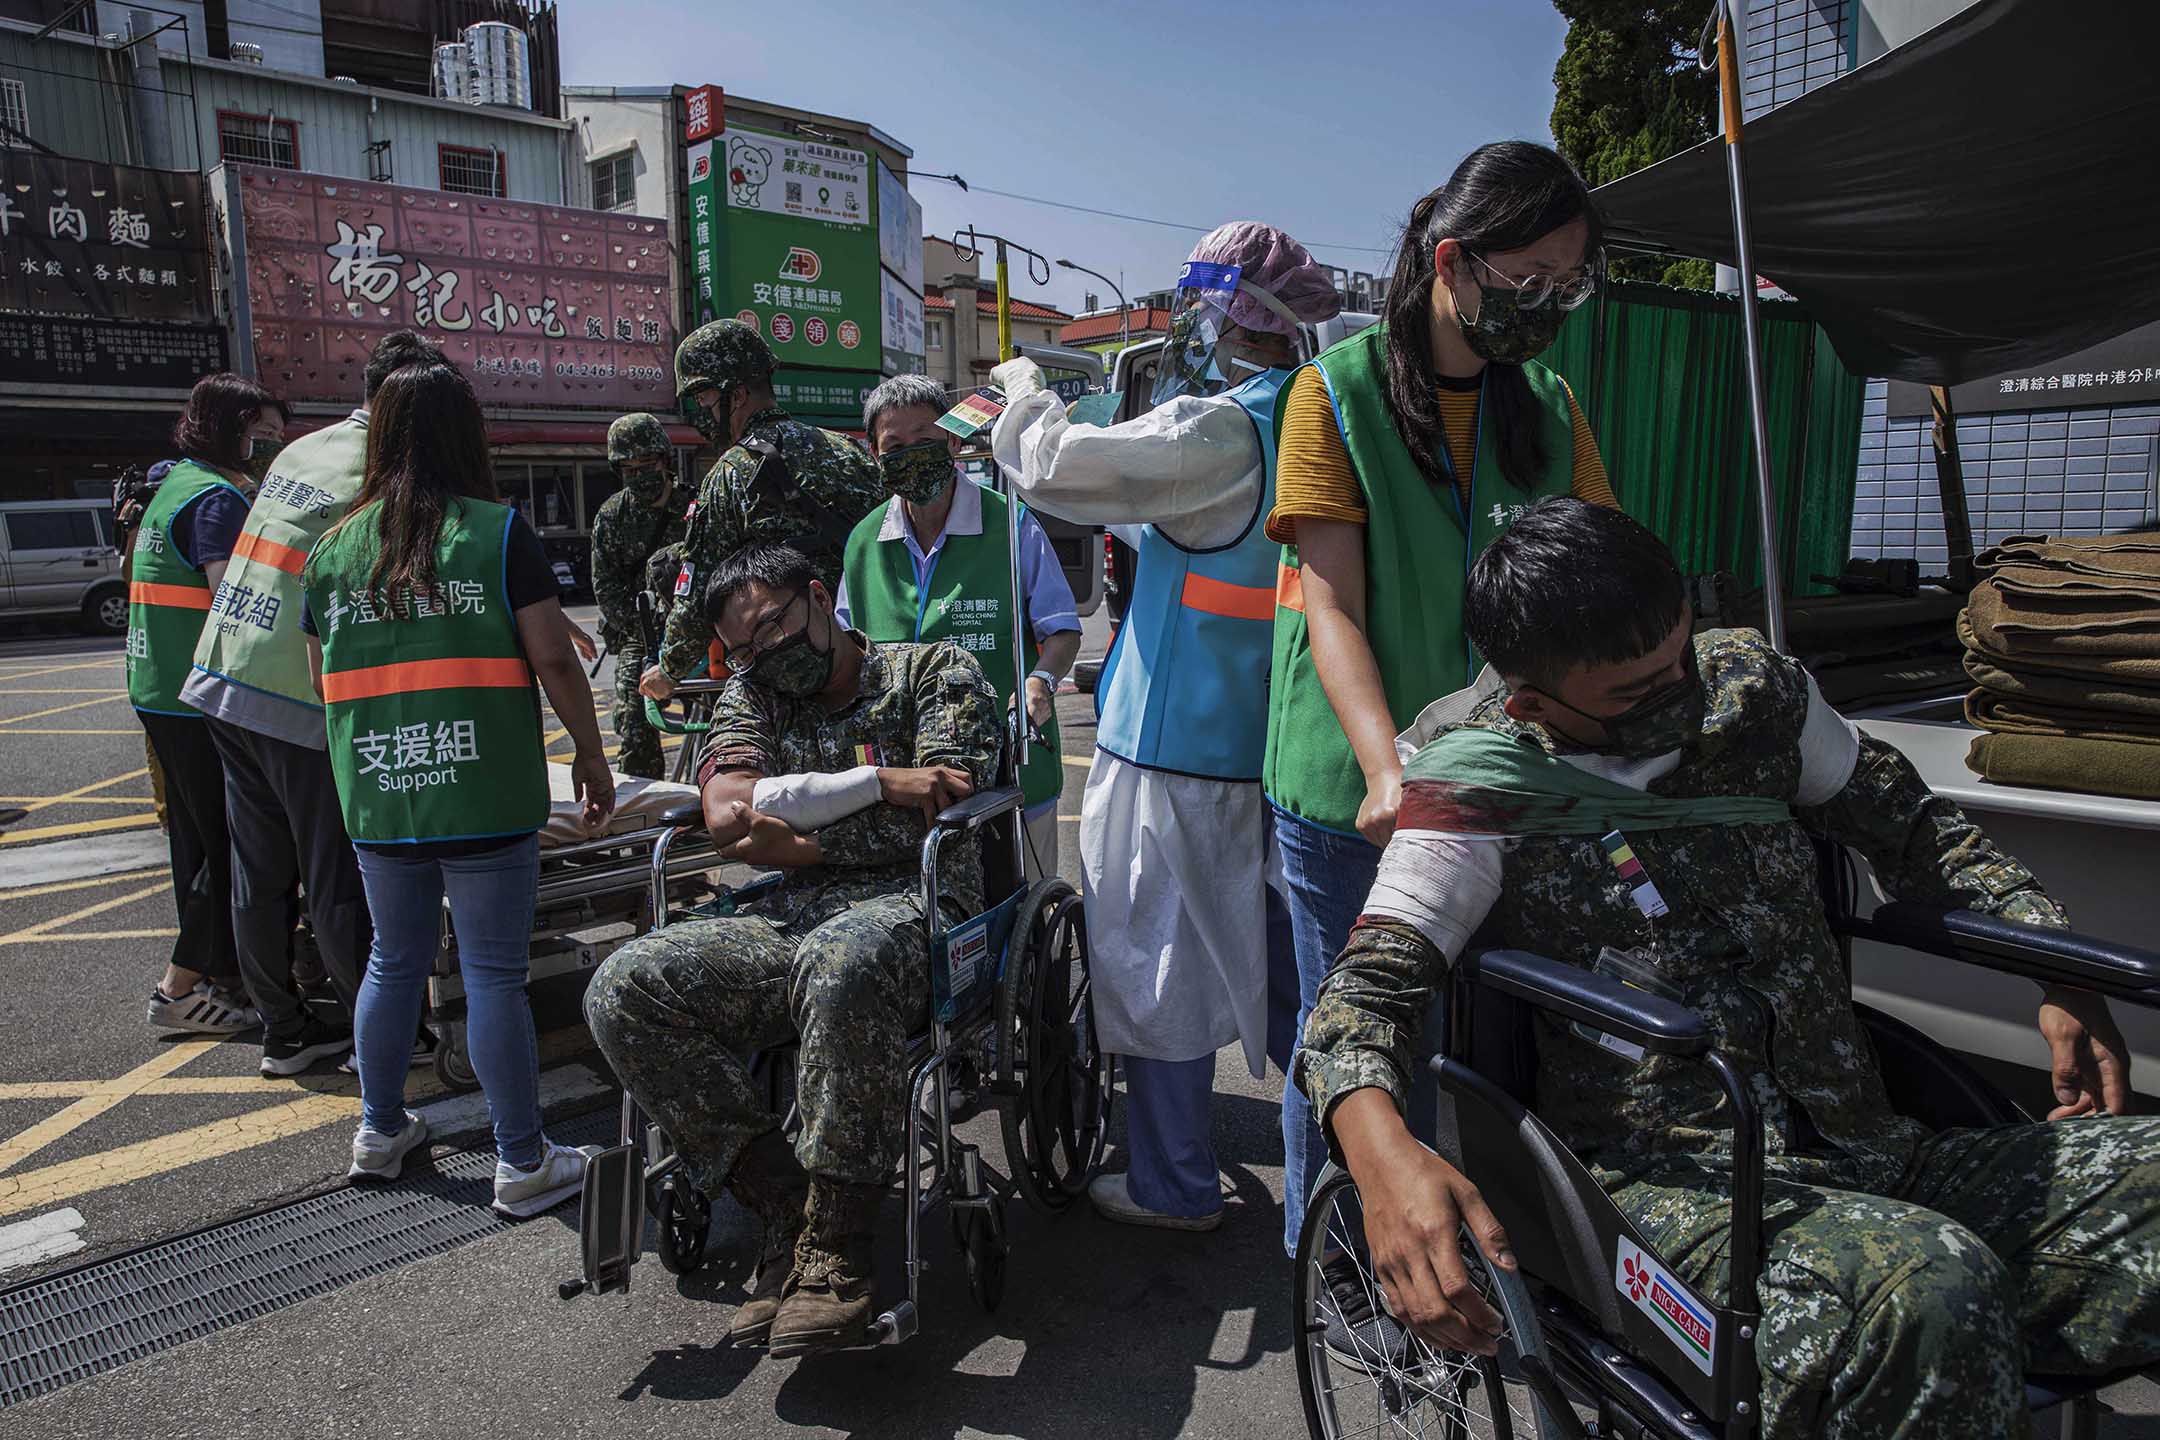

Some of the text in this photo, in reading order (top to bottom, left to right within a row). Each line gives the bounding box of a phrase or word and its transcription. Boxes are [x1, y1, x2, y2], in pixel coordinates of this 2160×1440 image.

[688, 91, 708, 134] 藥
[326, 219, 566, 339] 楊記小吃
[950, 599, 999, 612] 澄清醫院
[352, 719, 480, 775] 支援組
[378, 764, 458, 793] Support
[582, 950, 592, 966] 8
[1655, 1288, 1706, 1343] NICE CARE
